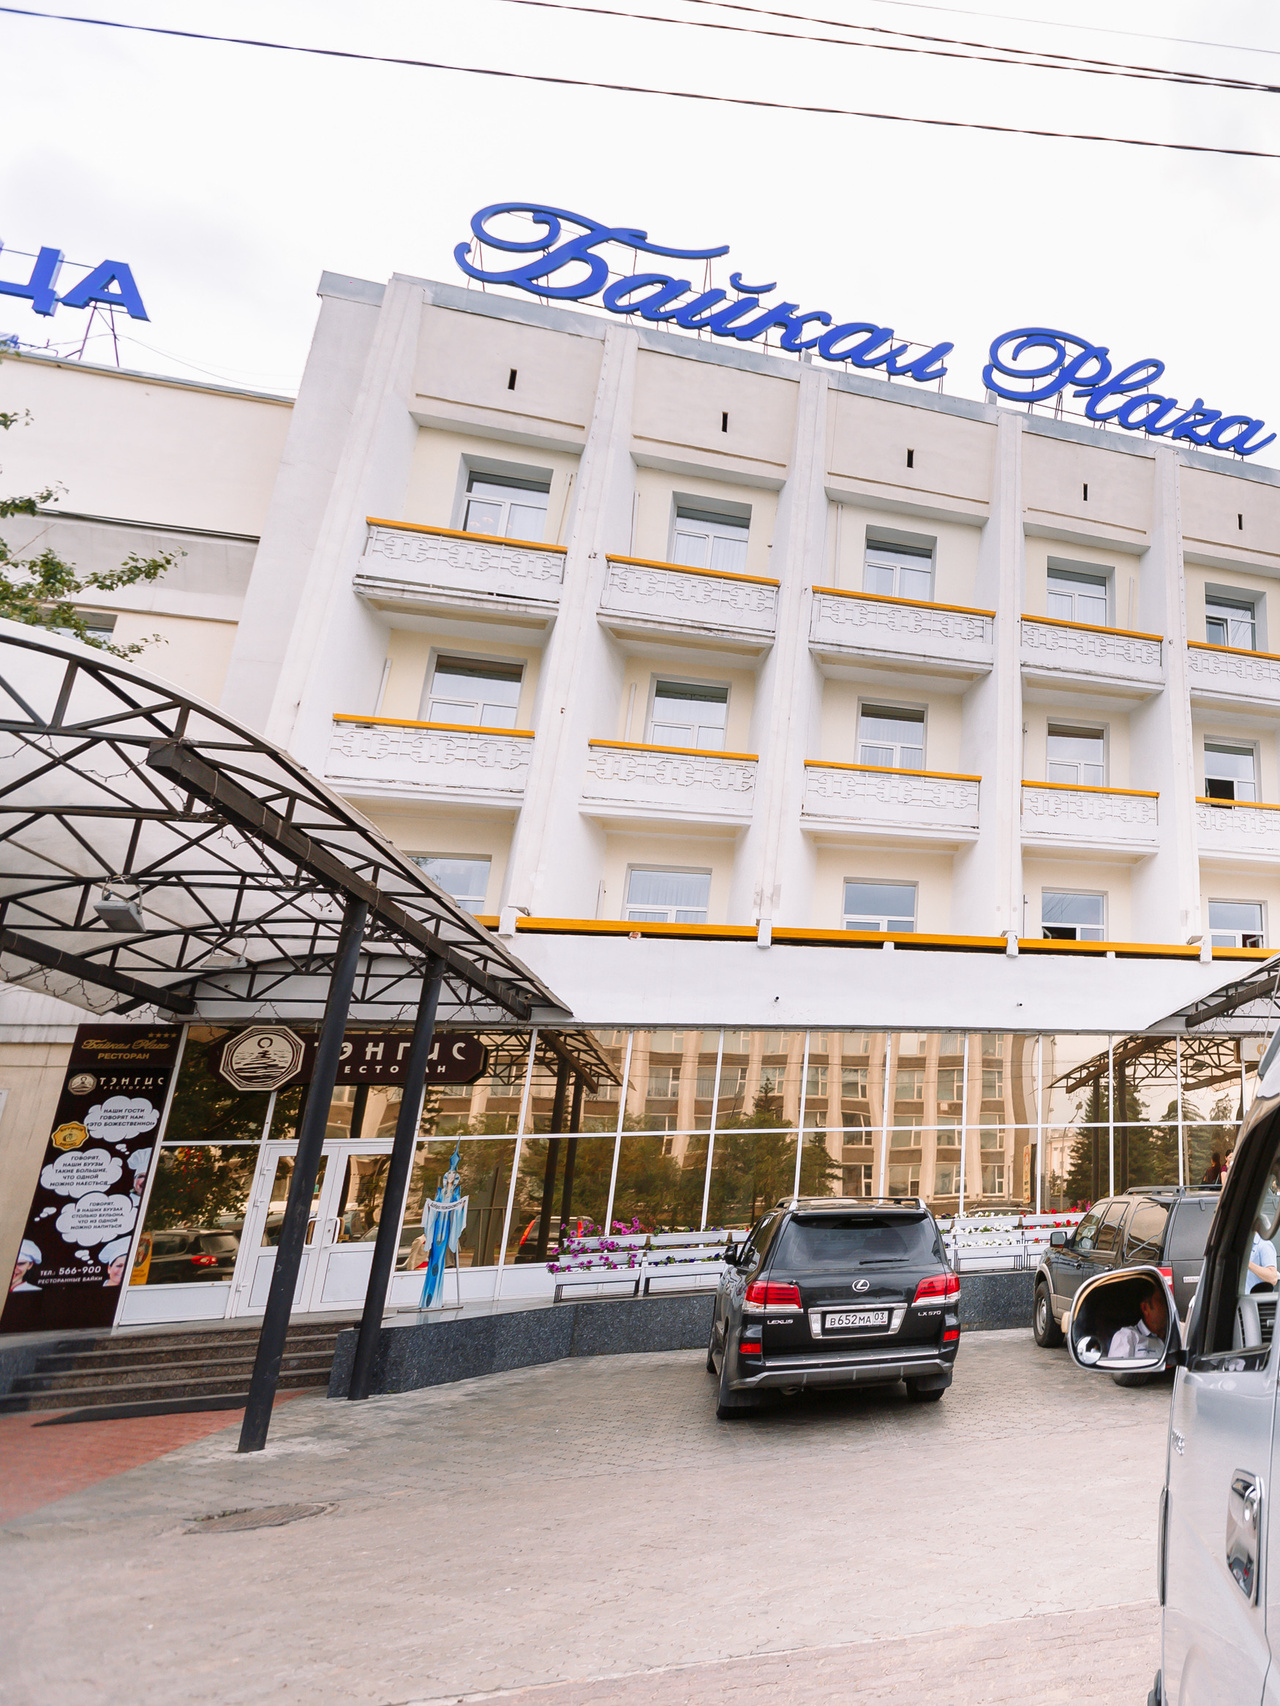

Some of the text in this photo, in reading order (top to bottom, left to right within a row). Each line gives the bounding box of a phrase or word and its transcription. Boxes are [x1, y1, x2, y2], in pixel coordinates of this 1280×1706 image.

[454, 202, 1278, 456] Байкал Plaza
[97, 1052, 150, 1060] РЕСТОРАН
[59, 1266, 102, 1275] 566-900
[37, 1277, 81, 1285] РЕСТОРАННЫЕ
[874, 1312, 885, 1320] 03
